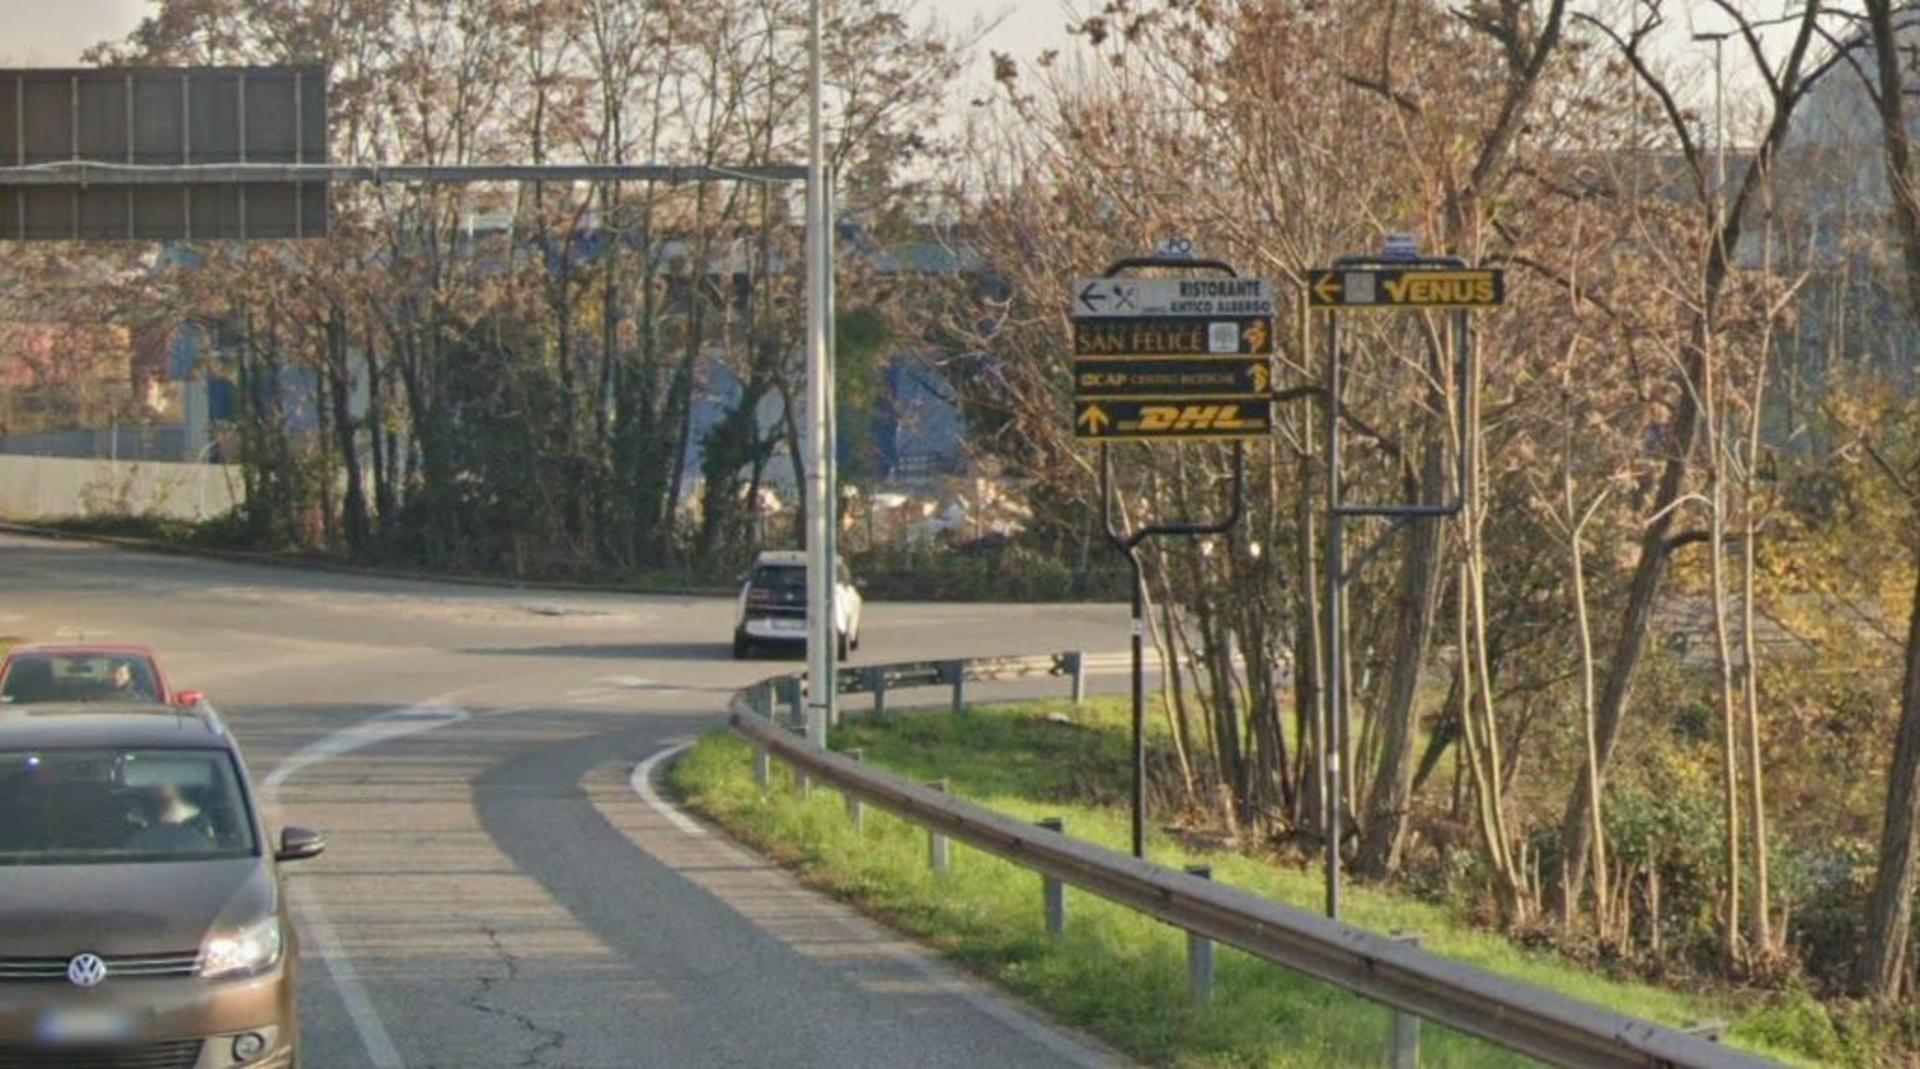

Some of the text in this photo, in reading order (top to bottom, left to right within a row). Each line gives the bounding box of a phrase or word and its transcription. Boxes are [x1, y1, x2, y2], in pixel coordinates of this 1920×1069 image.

[1179, 281, 1260, 297] RISTORANTE
[1384, 272, 1494, 303] VENUS
[1171, 301, 1213, 312] ANTICO
[1218, 301, 1271, 312] ALBERGO
[1079, 330, 1201, 352] SAN FELICE
[1138, 406, 1245, 430] DHL
